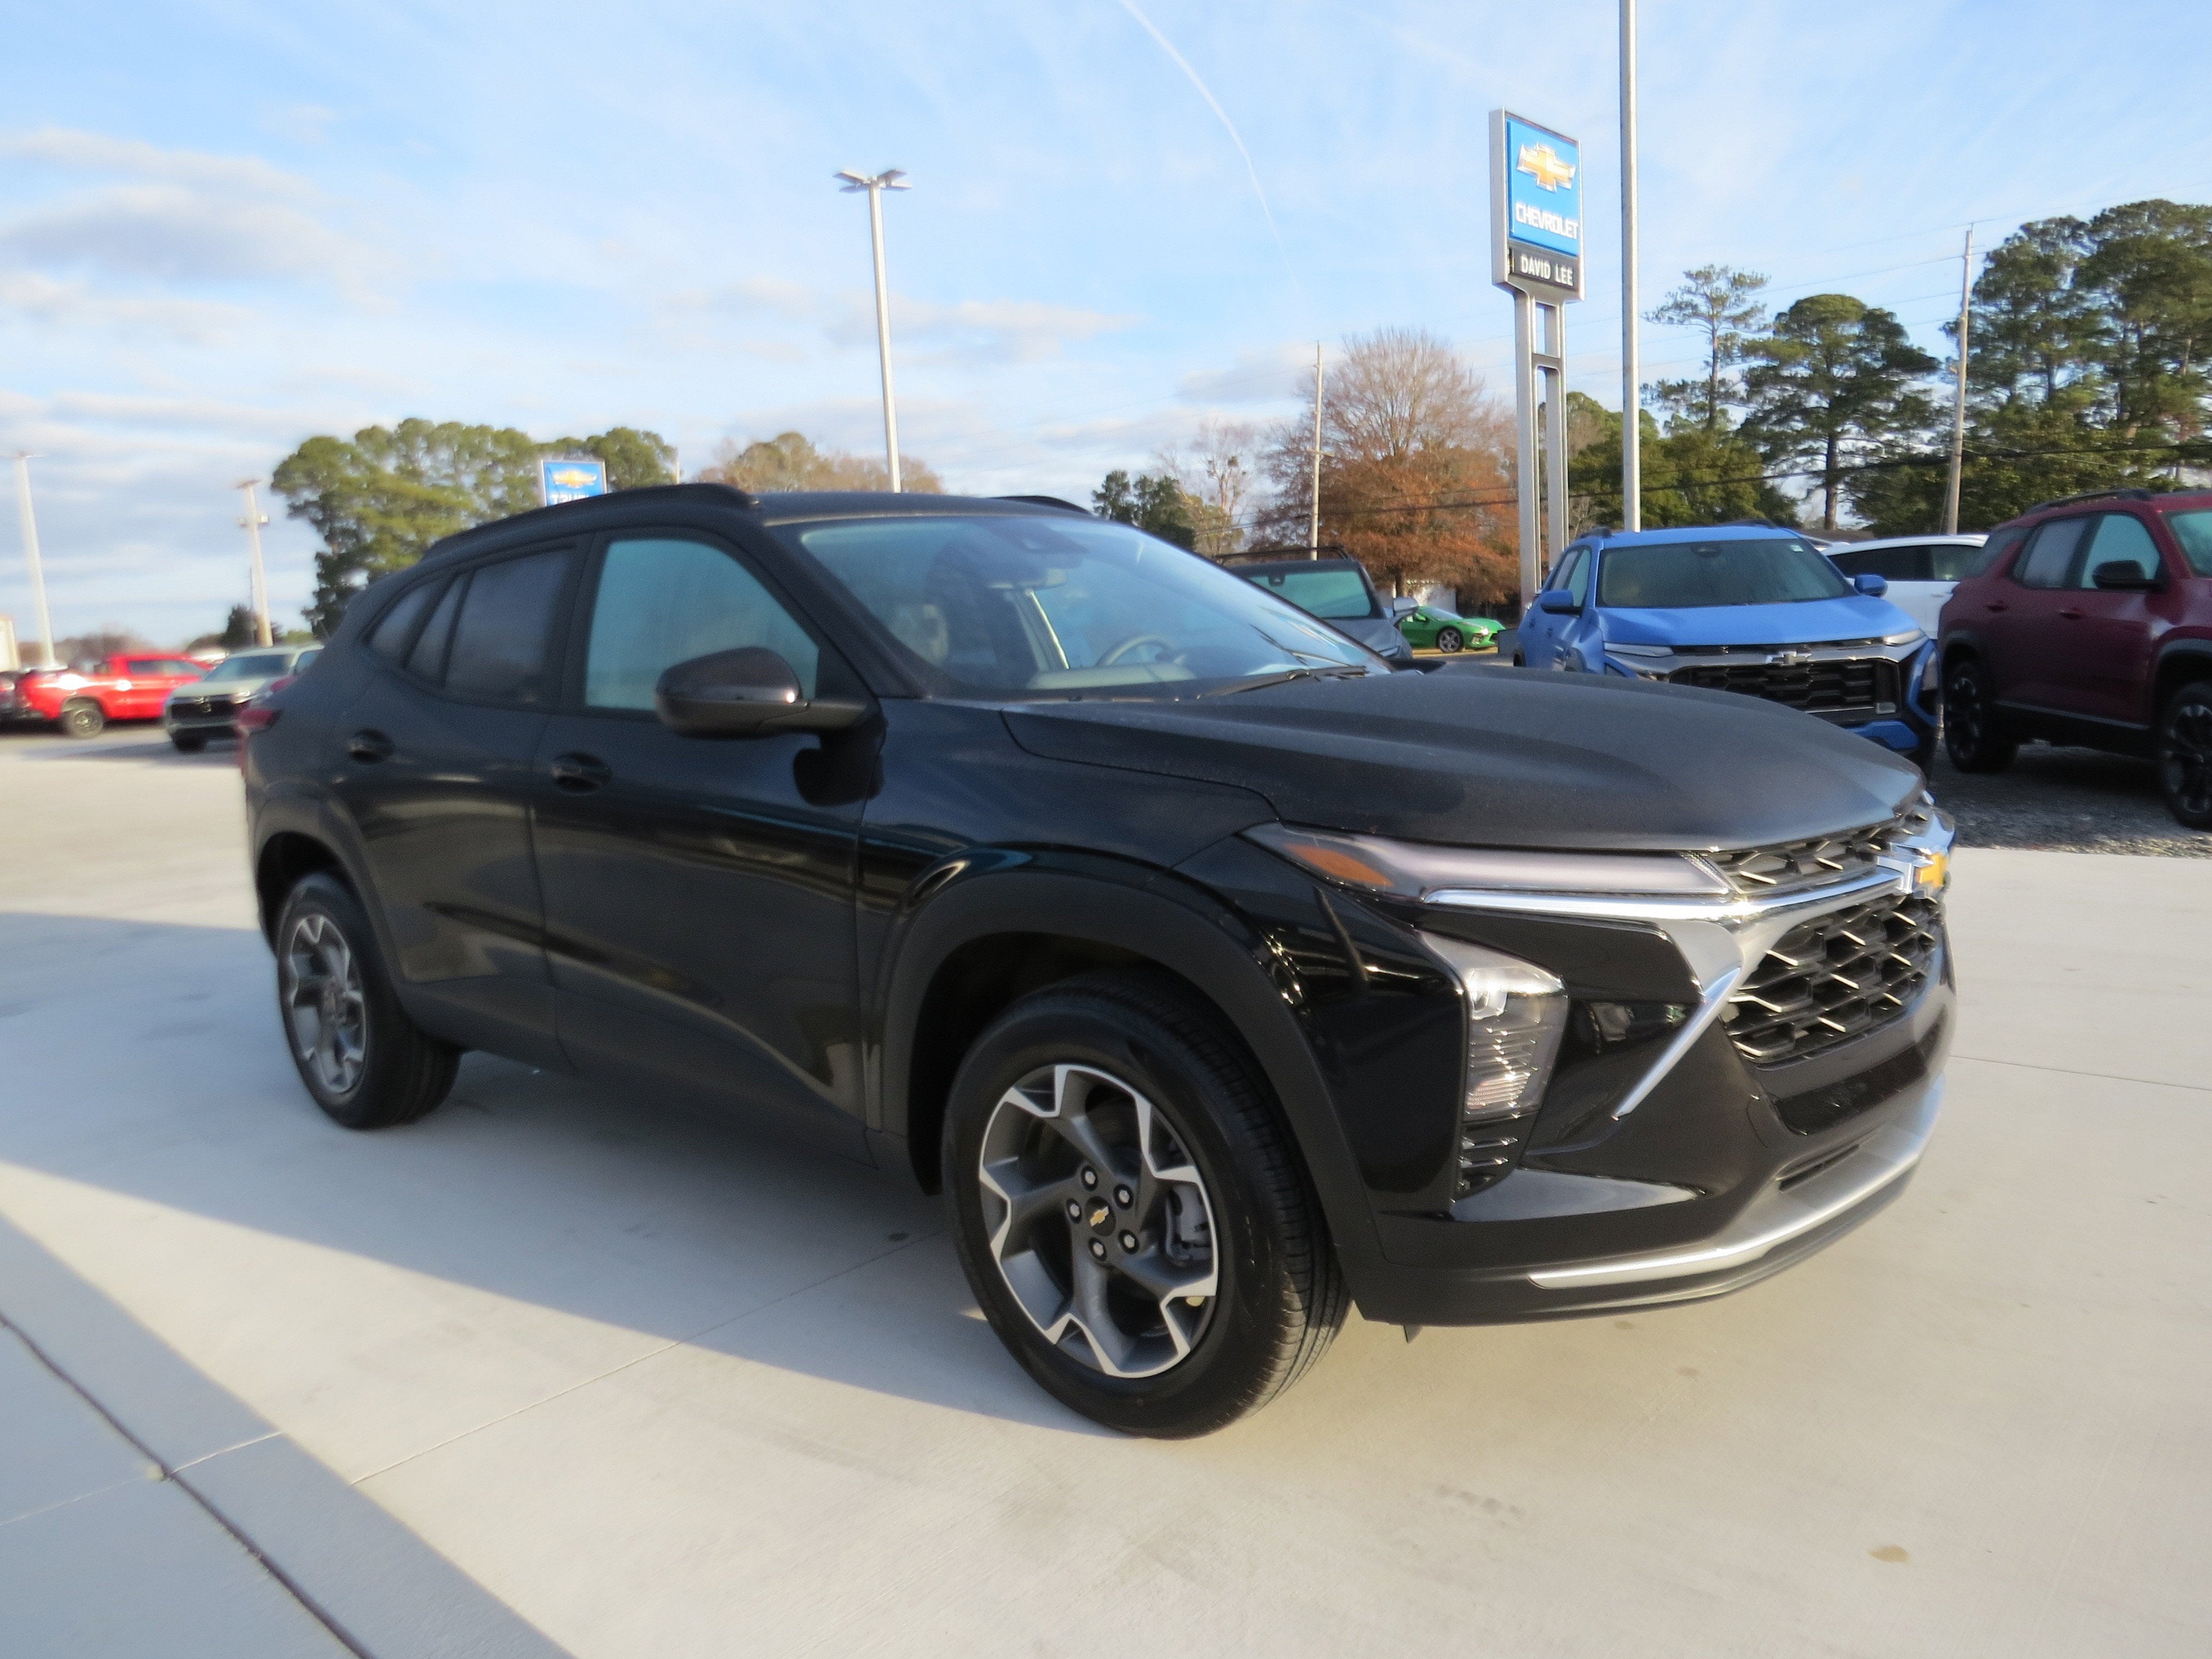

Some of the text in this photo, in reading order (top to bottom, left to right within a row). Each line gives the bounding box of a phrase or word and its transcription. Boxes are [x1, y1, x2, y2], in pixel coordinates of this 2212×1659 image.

[1515, 201, 1579, 239] CHEVROLET
[1520, 253, 1574, 286] DAVID LEE
